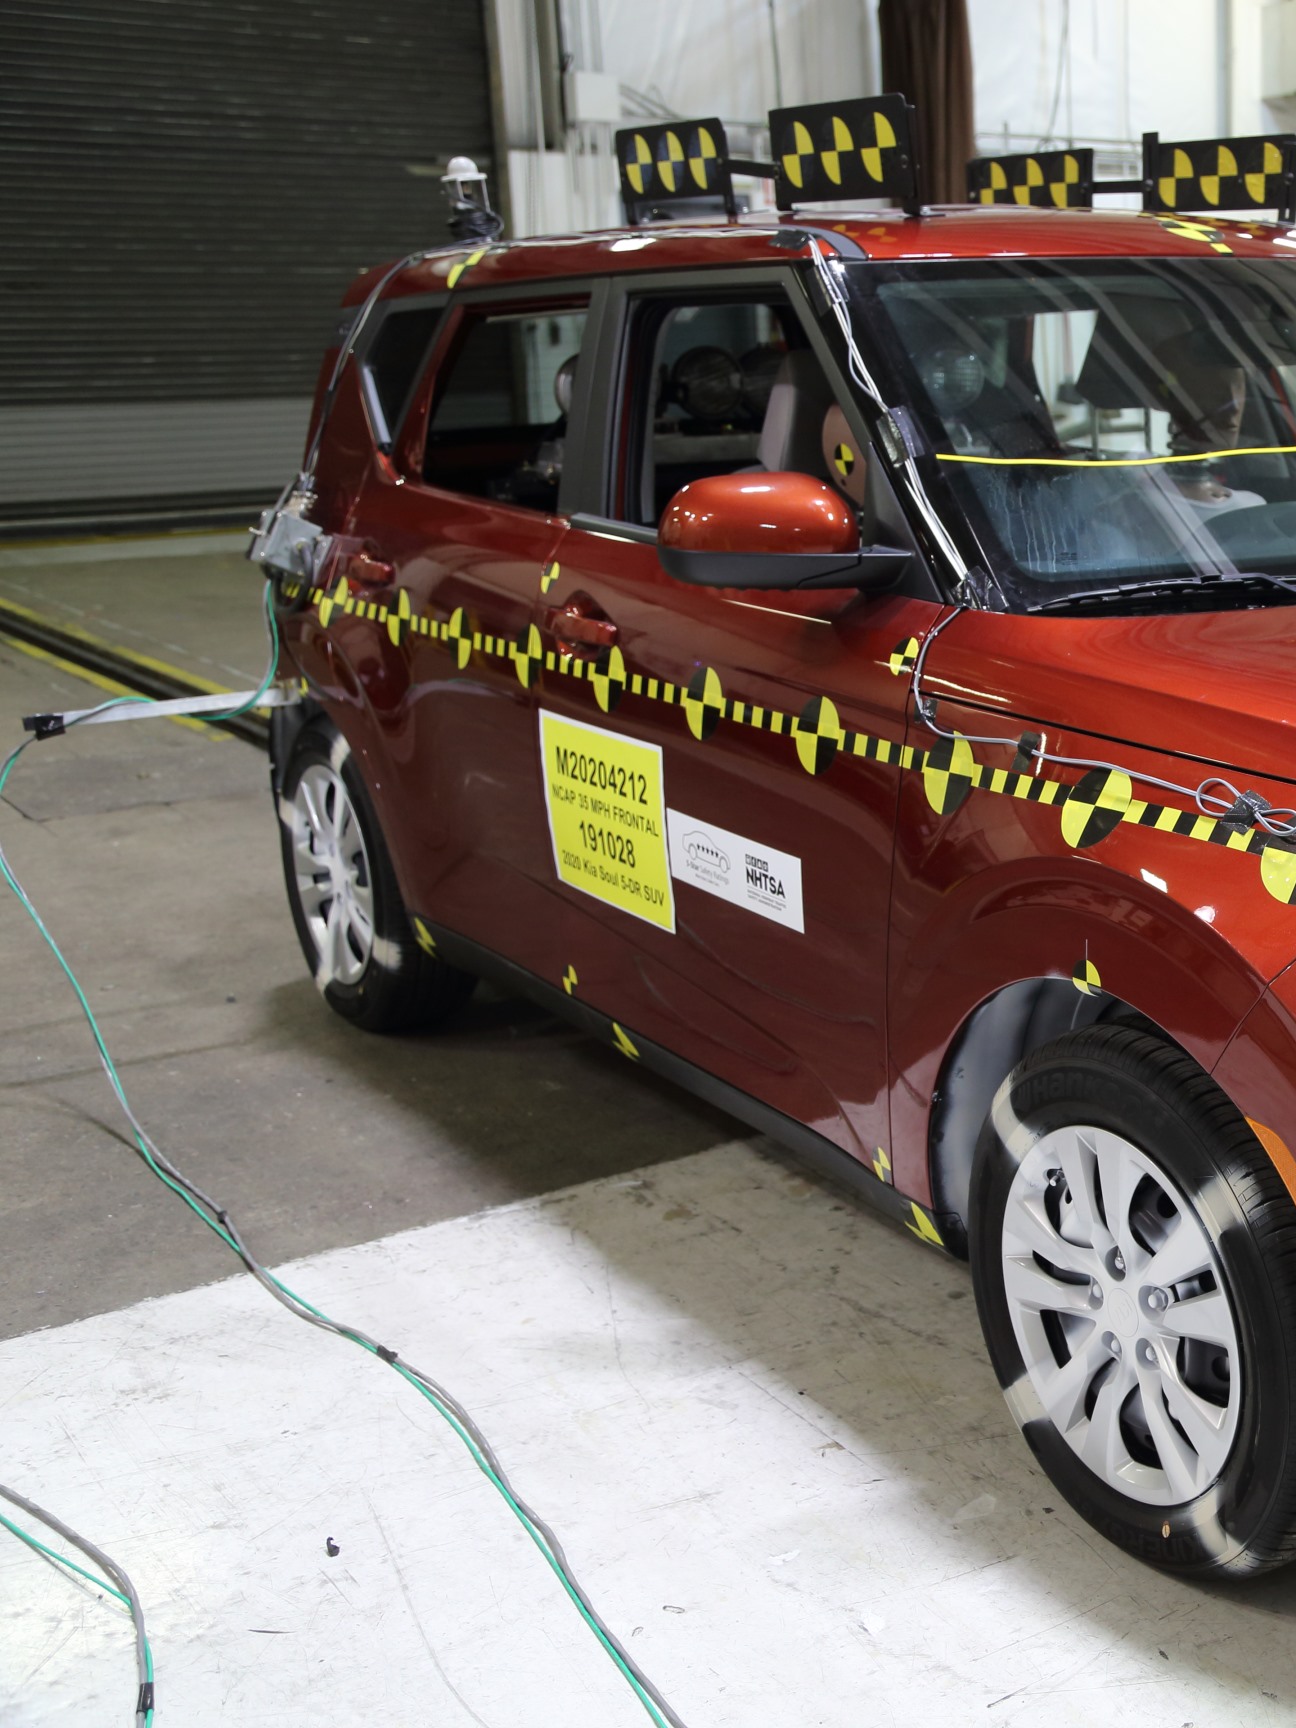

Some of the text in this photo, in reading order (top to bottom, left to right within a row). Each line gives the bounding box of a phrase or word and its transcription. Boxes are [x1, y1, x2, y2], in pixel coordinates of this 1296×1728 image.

[556, 746, 648, 805] M20204212
[552, 783, 577, 805] NCAP
[590, 798, 611, 819] MPH
[613, 805, 659, 837] FRONTAL
[579, 821, 636, 868] 191028
[583, 859, 597, 878] Kia
[599, 865, 620, 886] Soul
[620, 875, 642, 898] 5-DR
[643, 885, 665, 906] SUV
[745, 865, 786, 899] NHTSA
